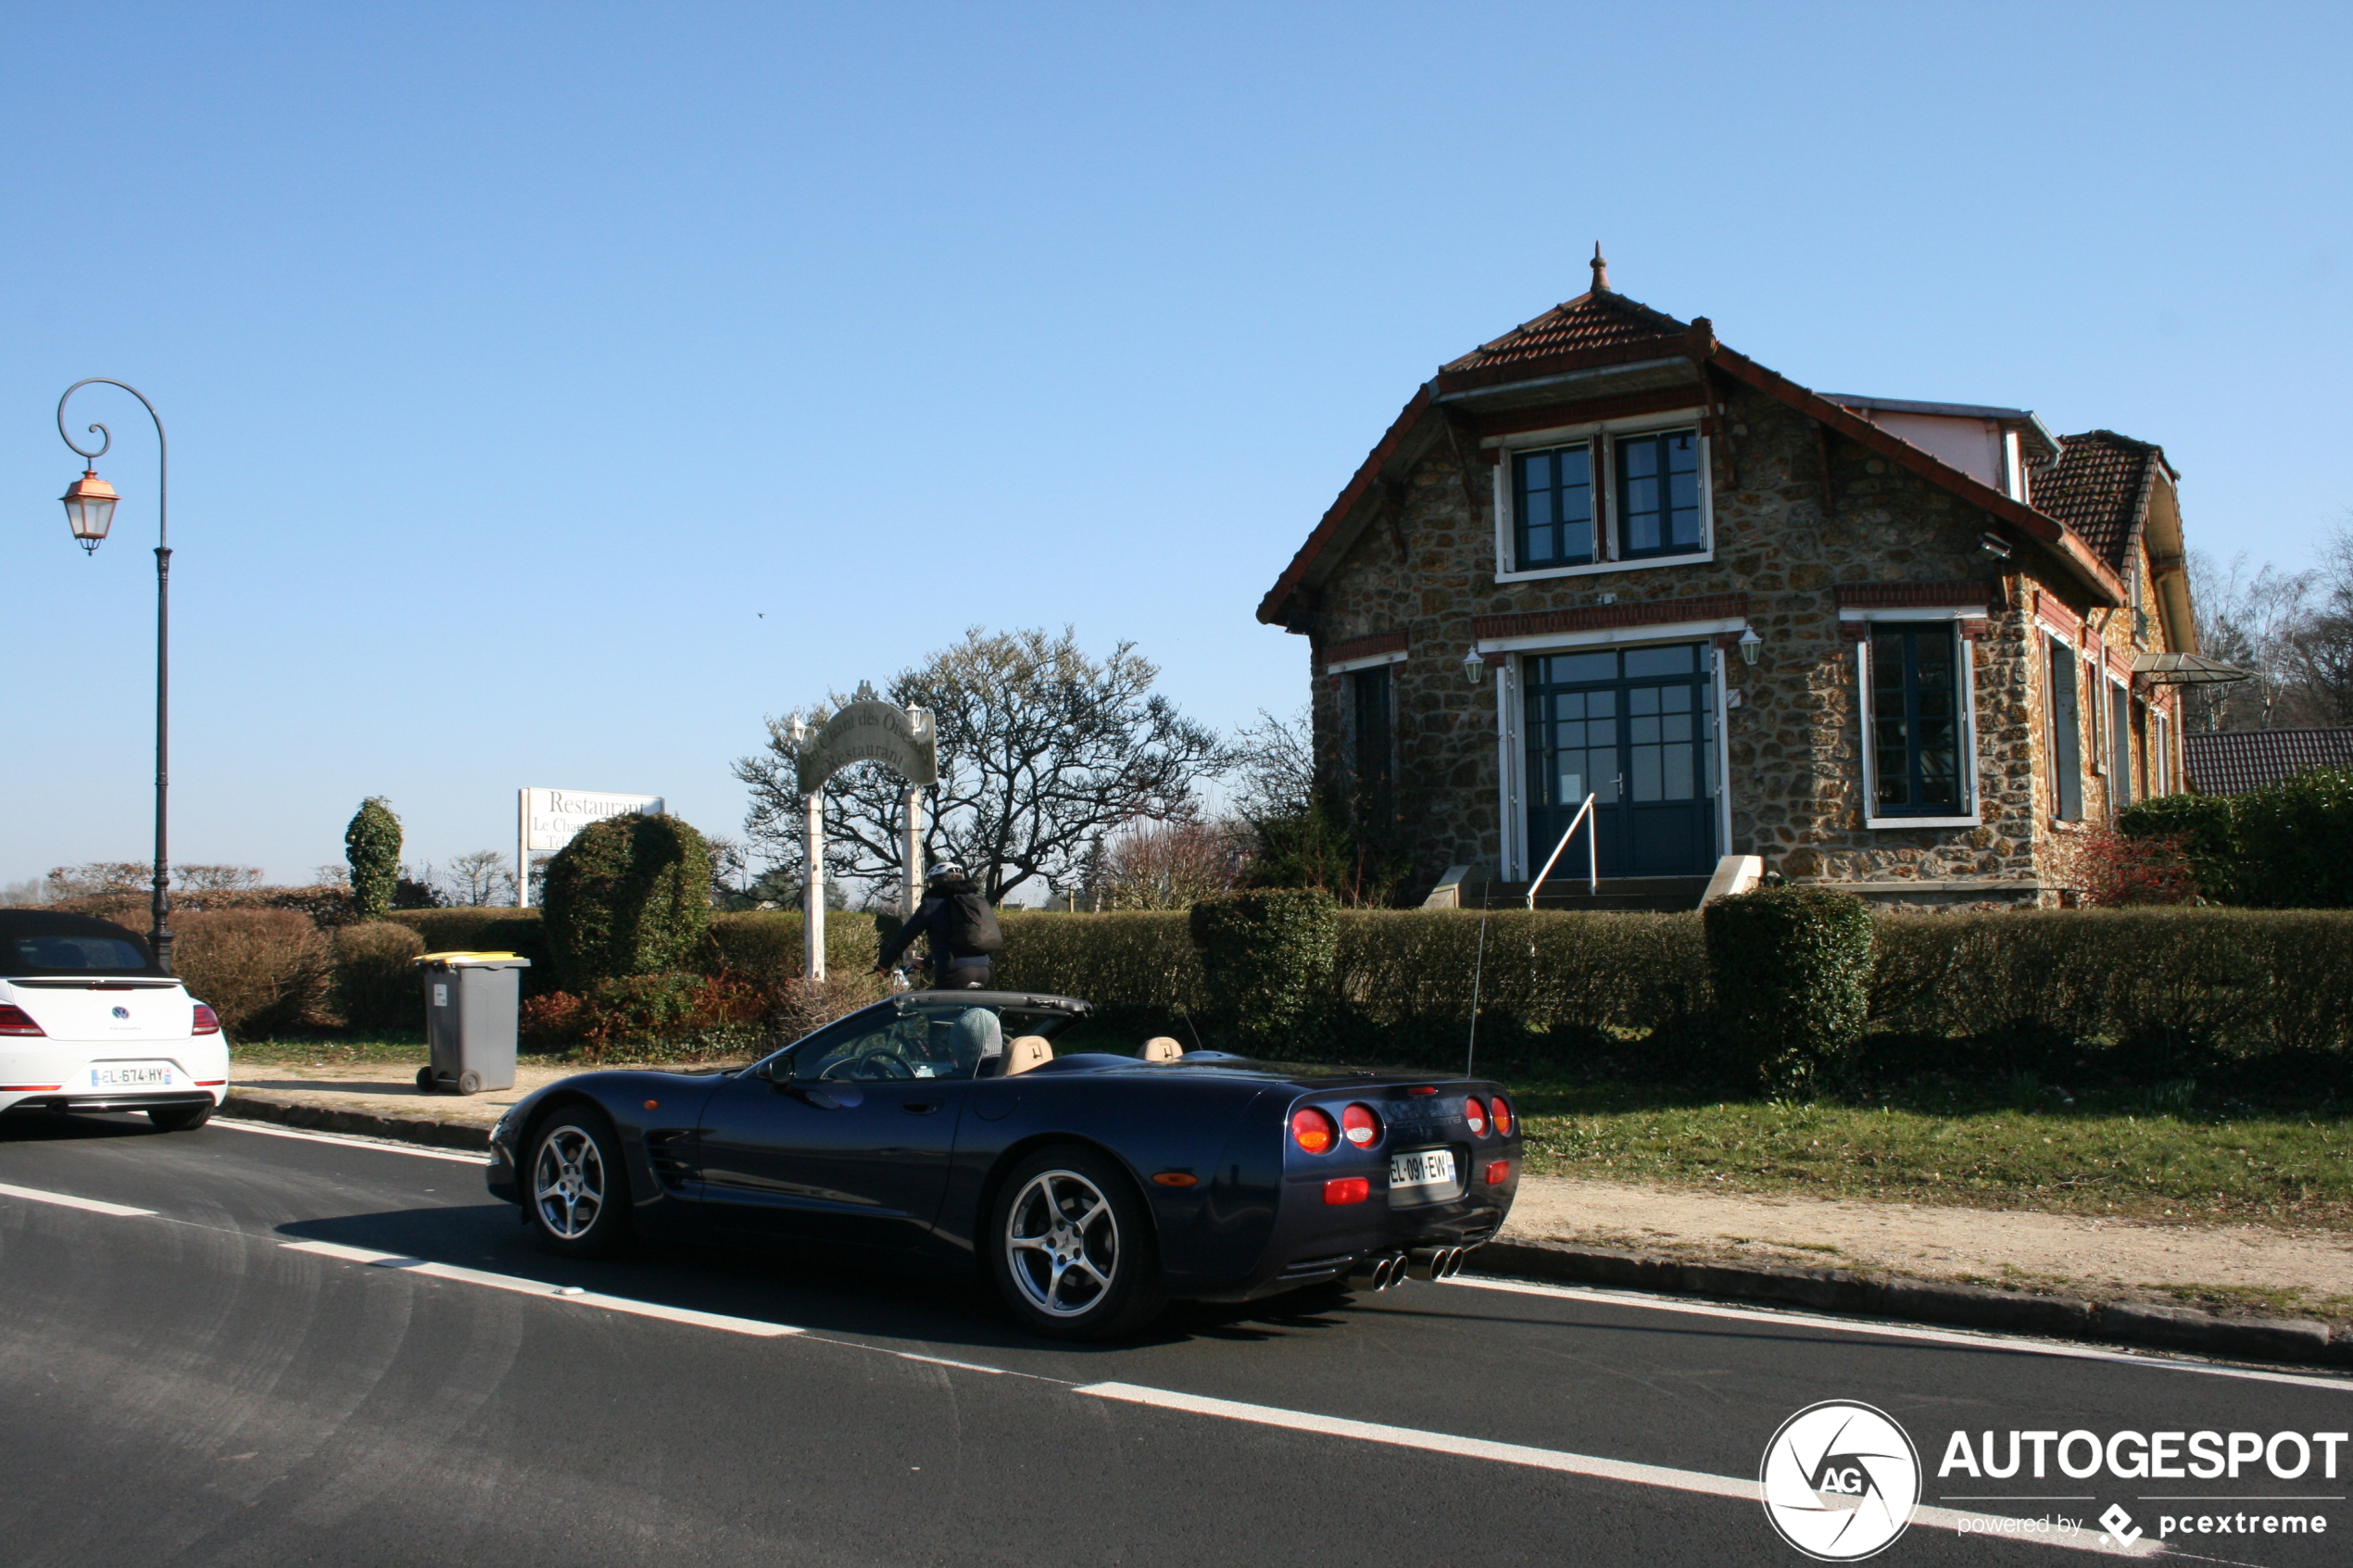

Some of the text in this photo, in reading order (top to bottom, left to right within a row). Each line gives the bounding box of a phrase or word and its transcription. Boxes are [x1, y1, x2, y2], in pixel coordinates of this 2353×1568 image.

[819, 717, 855, 749] Chant
[859, 709, 879, 726] des
[826, 744, 904, 772] Restaurant
[534, 816, 549, 832] Le
